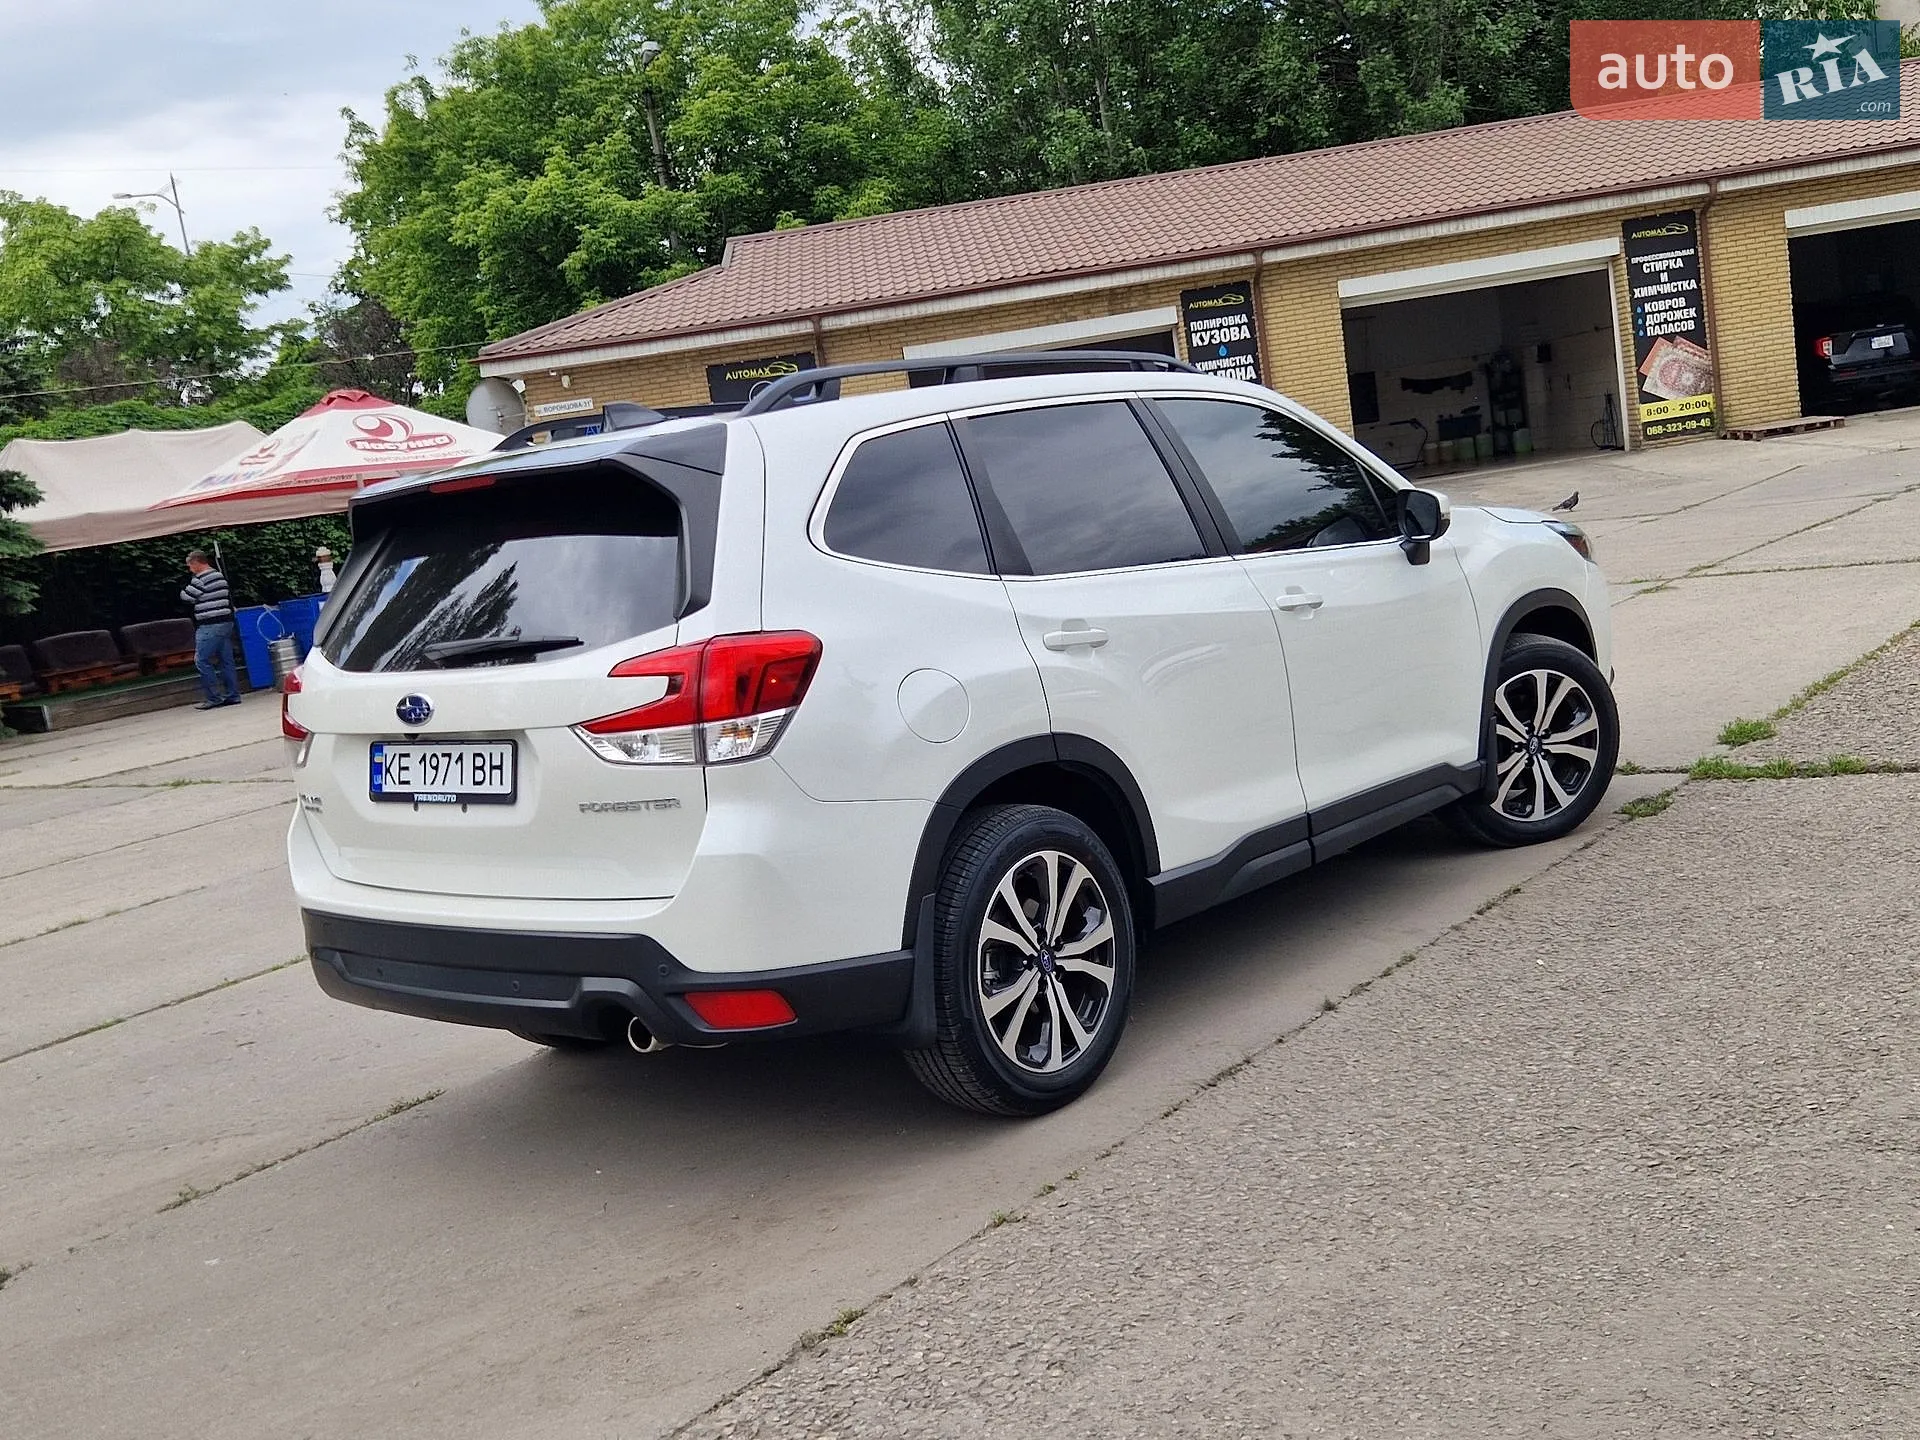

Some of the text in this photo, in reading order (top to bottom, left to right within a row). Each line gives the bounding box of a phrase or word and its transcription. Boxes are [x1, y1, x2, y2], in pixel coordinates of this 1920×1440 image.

[1631, 227, 1667, 239] AUTOMAX
[1631, 248, 1695, 265] ПРОФЕССИОНАЛЬНАЯ
[1642, 257, 1684, 274] СТИРКА
[1660, 271, 1669, 283] И
[1633, 279, 1698, 299] ХИМЧИСТКА
[1188, 299, 1222, 310] AUTOMAX
[1644, 297, 1686, 313] КОВРОВ
[1190, 313, 1249, 332] ПОЛИРОВКА
[1645, 307, 1698, 327] ДОРОЖЕК
[1191, 325, 1251, 347] КУЗОВА
[1646, 320, 1696, 337] ПАЛАСОВ
[1195, 354, 1254, 372] ХИМЧИСТКА
[725, 367, 771, 381] AUTOMAX
[1207, 365, 1257, 381] ЛОНА
[1646, 406, 1669, 417] 8:00
[1679, 400, 1708, 412] 20:00
[384, 751, 504, 786] KE 1971 BH
[579, 798, 682, 813] FORESTER
